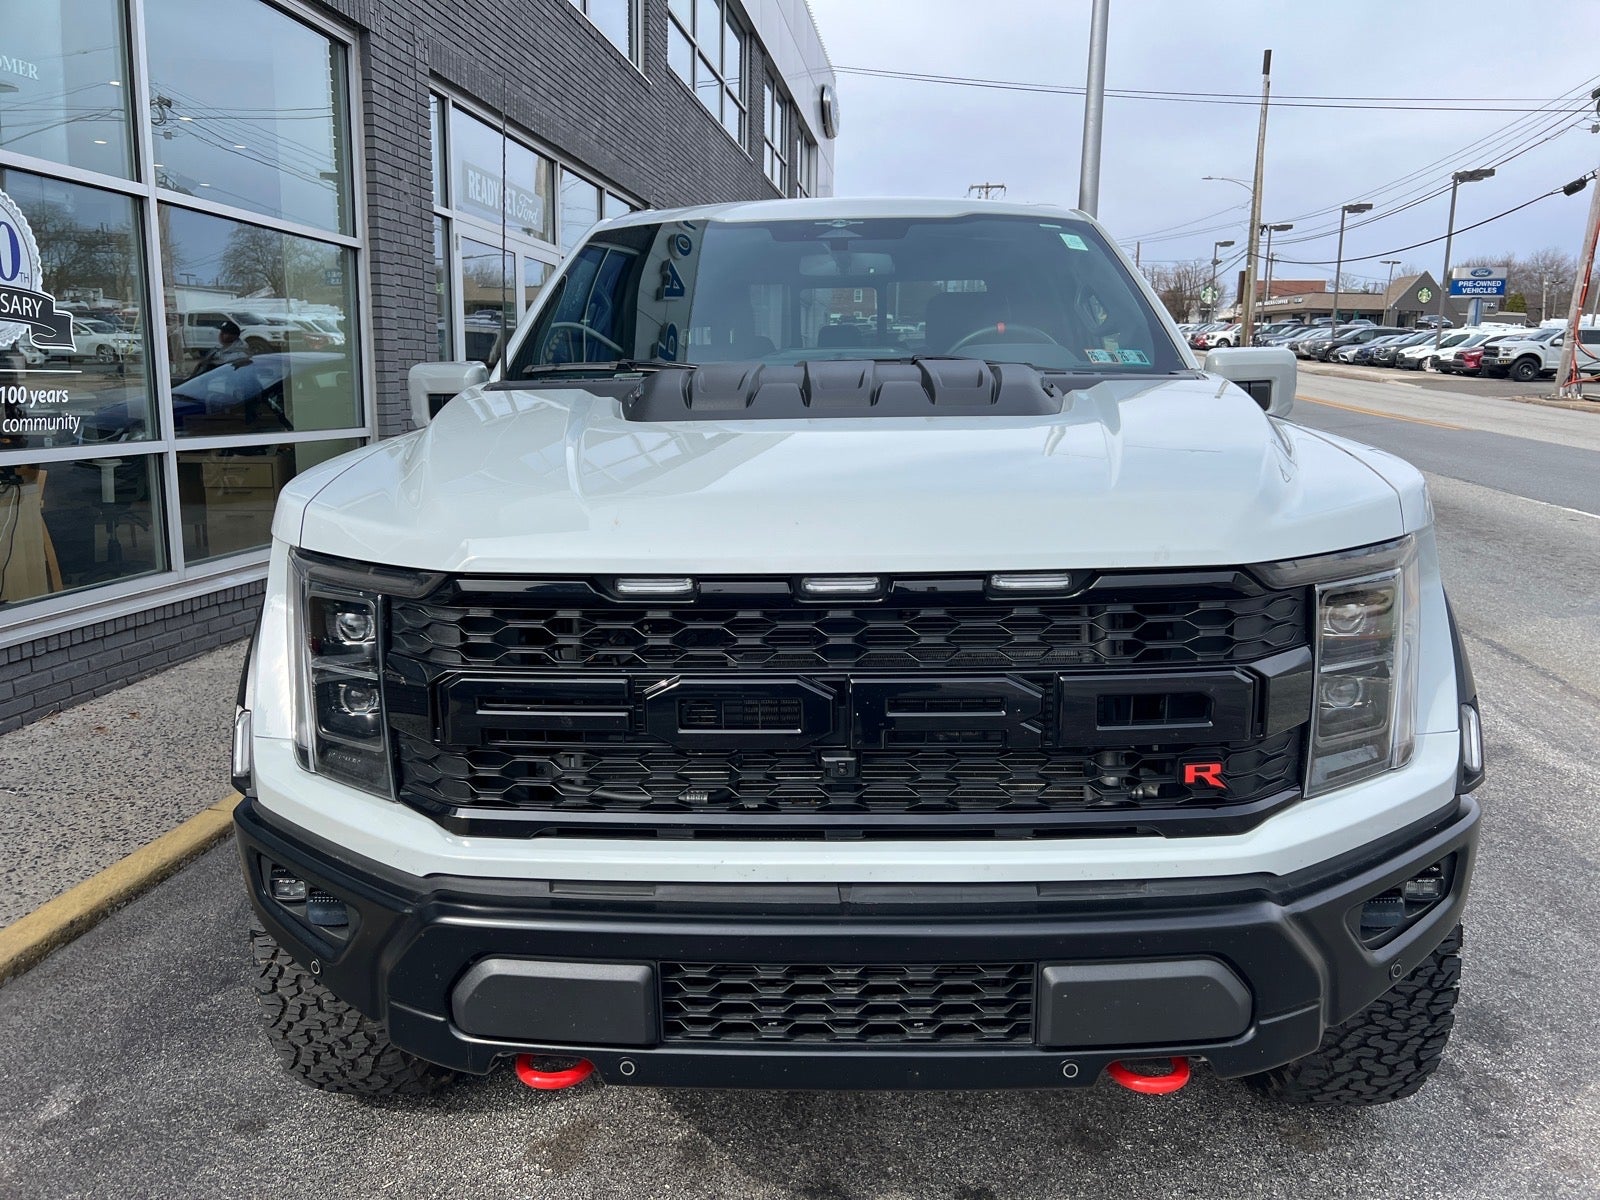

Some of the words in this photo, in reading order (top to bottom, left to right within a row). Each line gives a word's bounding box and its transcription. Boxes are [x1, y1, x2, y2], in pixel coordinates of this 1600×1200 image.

[0, 55, 39, 80] MER
[468, 169, 499, 210] READY
[517, 193, 539, 225] Ford
[0, 293, 43, 319] SARY
[0, 386, 27, 404] 100
[30, 389, 69, 408] years
[2, 412, 80, 434] community
[445, 672, 1254, 749] FORD
[1184, 763, 1227, 789] R
